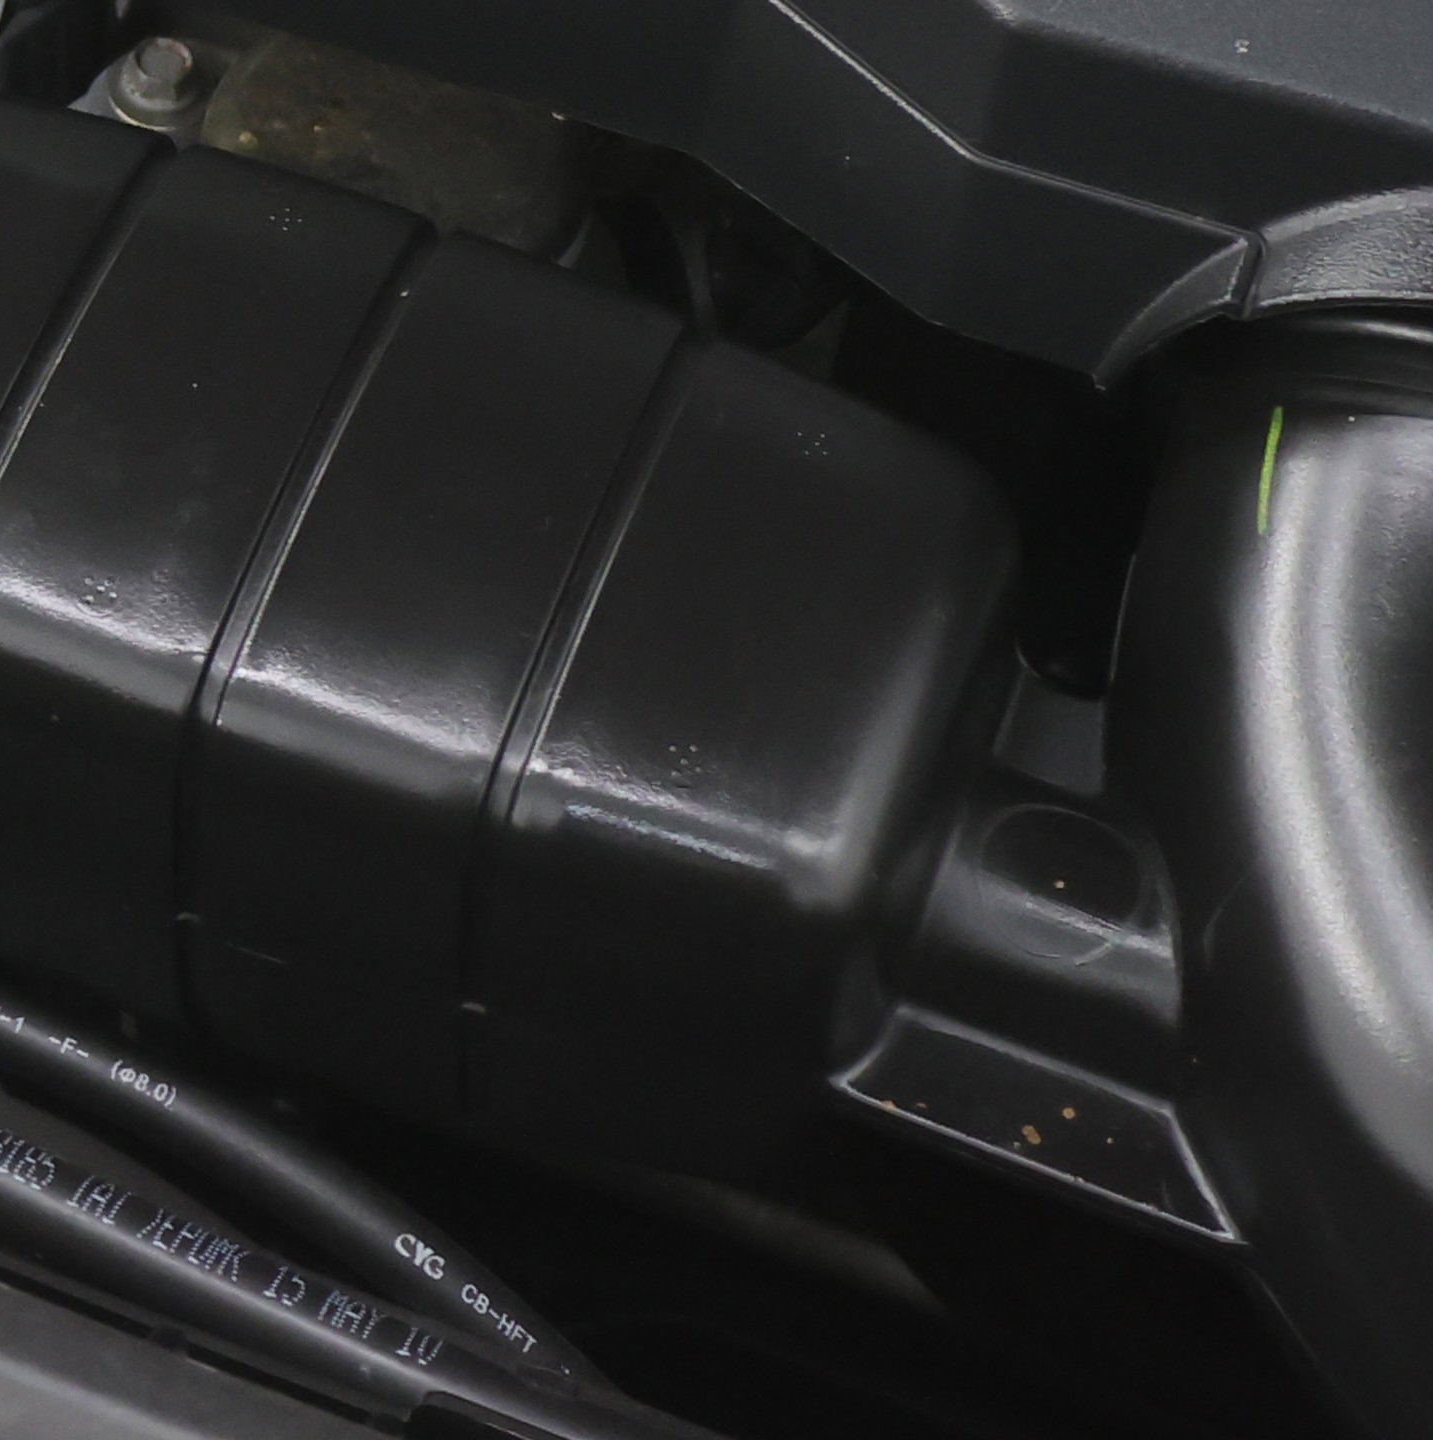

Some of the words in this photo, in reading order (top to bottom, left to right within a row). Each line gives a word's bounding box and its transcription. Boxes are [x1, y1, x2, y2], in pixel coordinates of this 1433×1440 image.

[318, 1289, 387, 1340] MAY
[394, 1232, 446, 1281] CYG
[460, 1283, 538, 1354] CB-HFT
